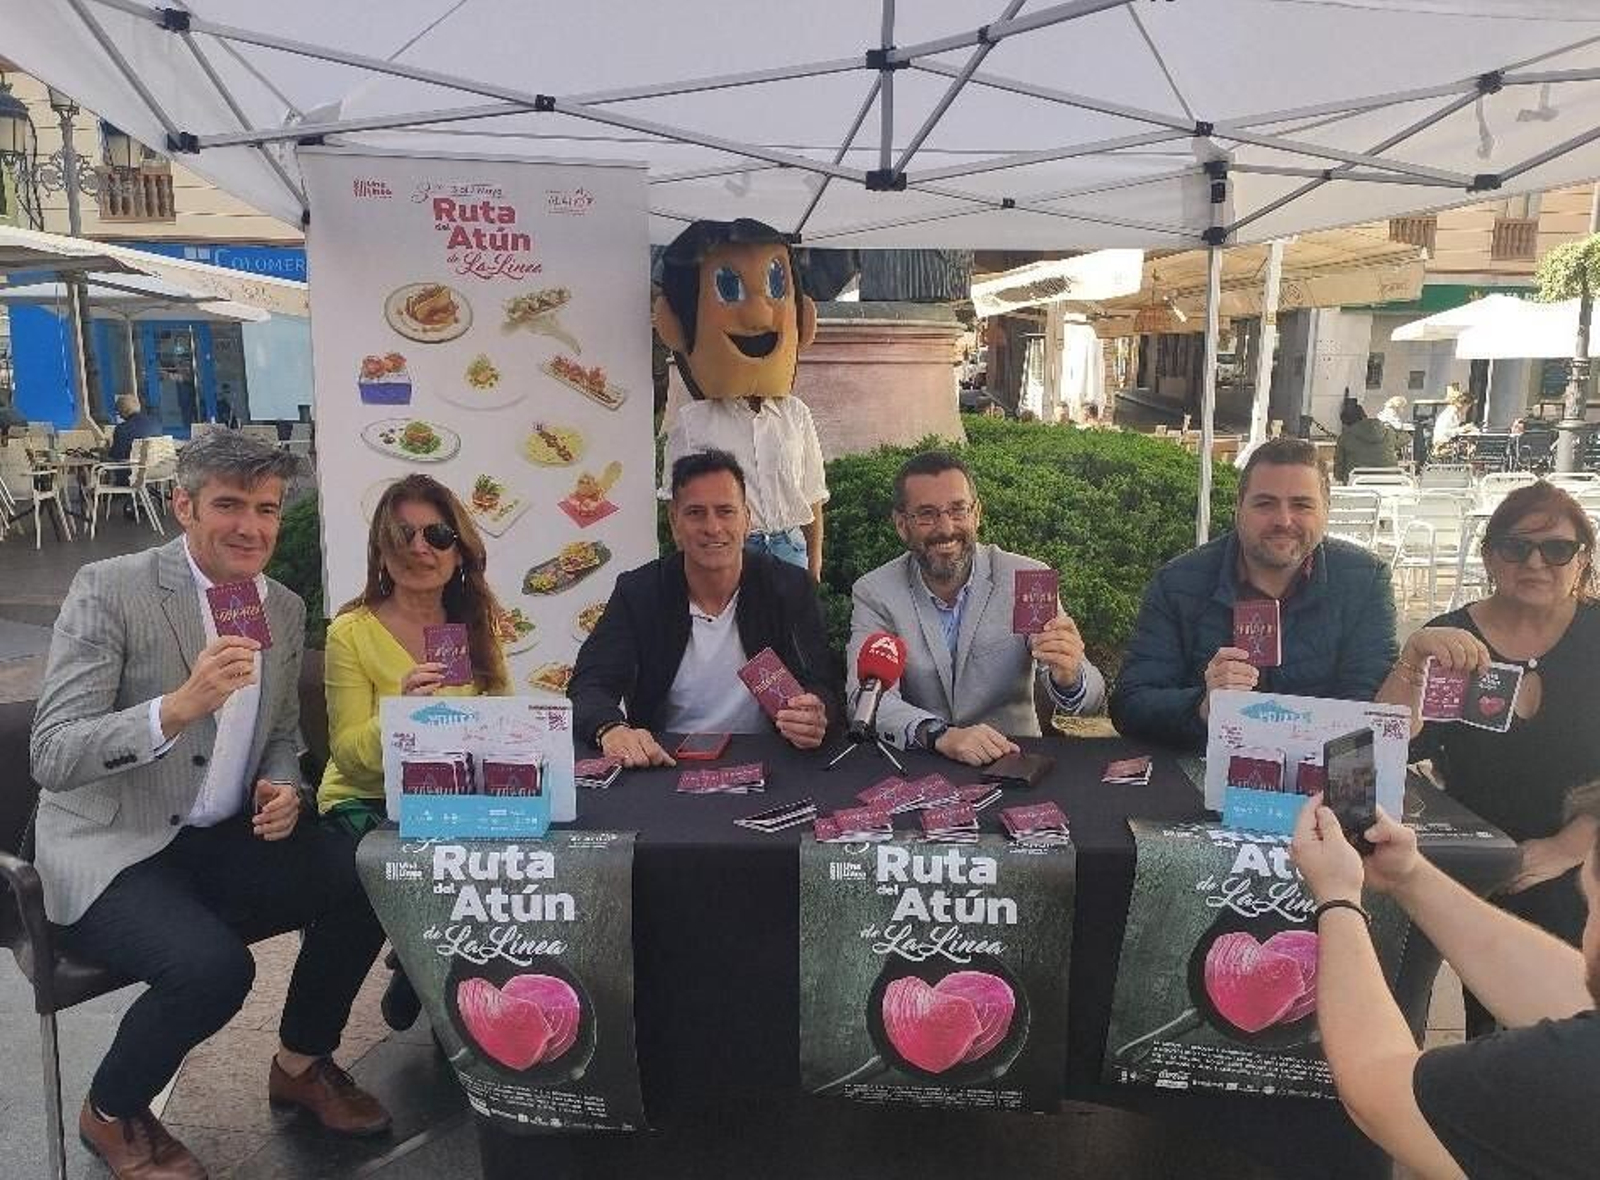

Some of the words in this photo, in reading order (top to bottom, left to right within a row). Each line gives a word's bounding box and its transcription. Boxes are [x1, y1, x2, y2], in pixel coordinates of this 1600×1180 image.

[433, 197, 516, 224] Ruta
[447, 224, 531, 252] Atún
[433, 844, 555, 881] Ruta
[876, 844, 998, 885] Ruta
[1230, 843, 1304, 881] At
[433, 882, 455, 894] del
[450, 884, 576, 923] Atún
[876, 884, 898, 896] del
[890, 887, 1018, 925] Atún
[1205, 876, 1262, 918] La
[1251, 882, 1317, 923] Lín
[436, 925, 489, 965] La
[872, 924, 927, 962] La
